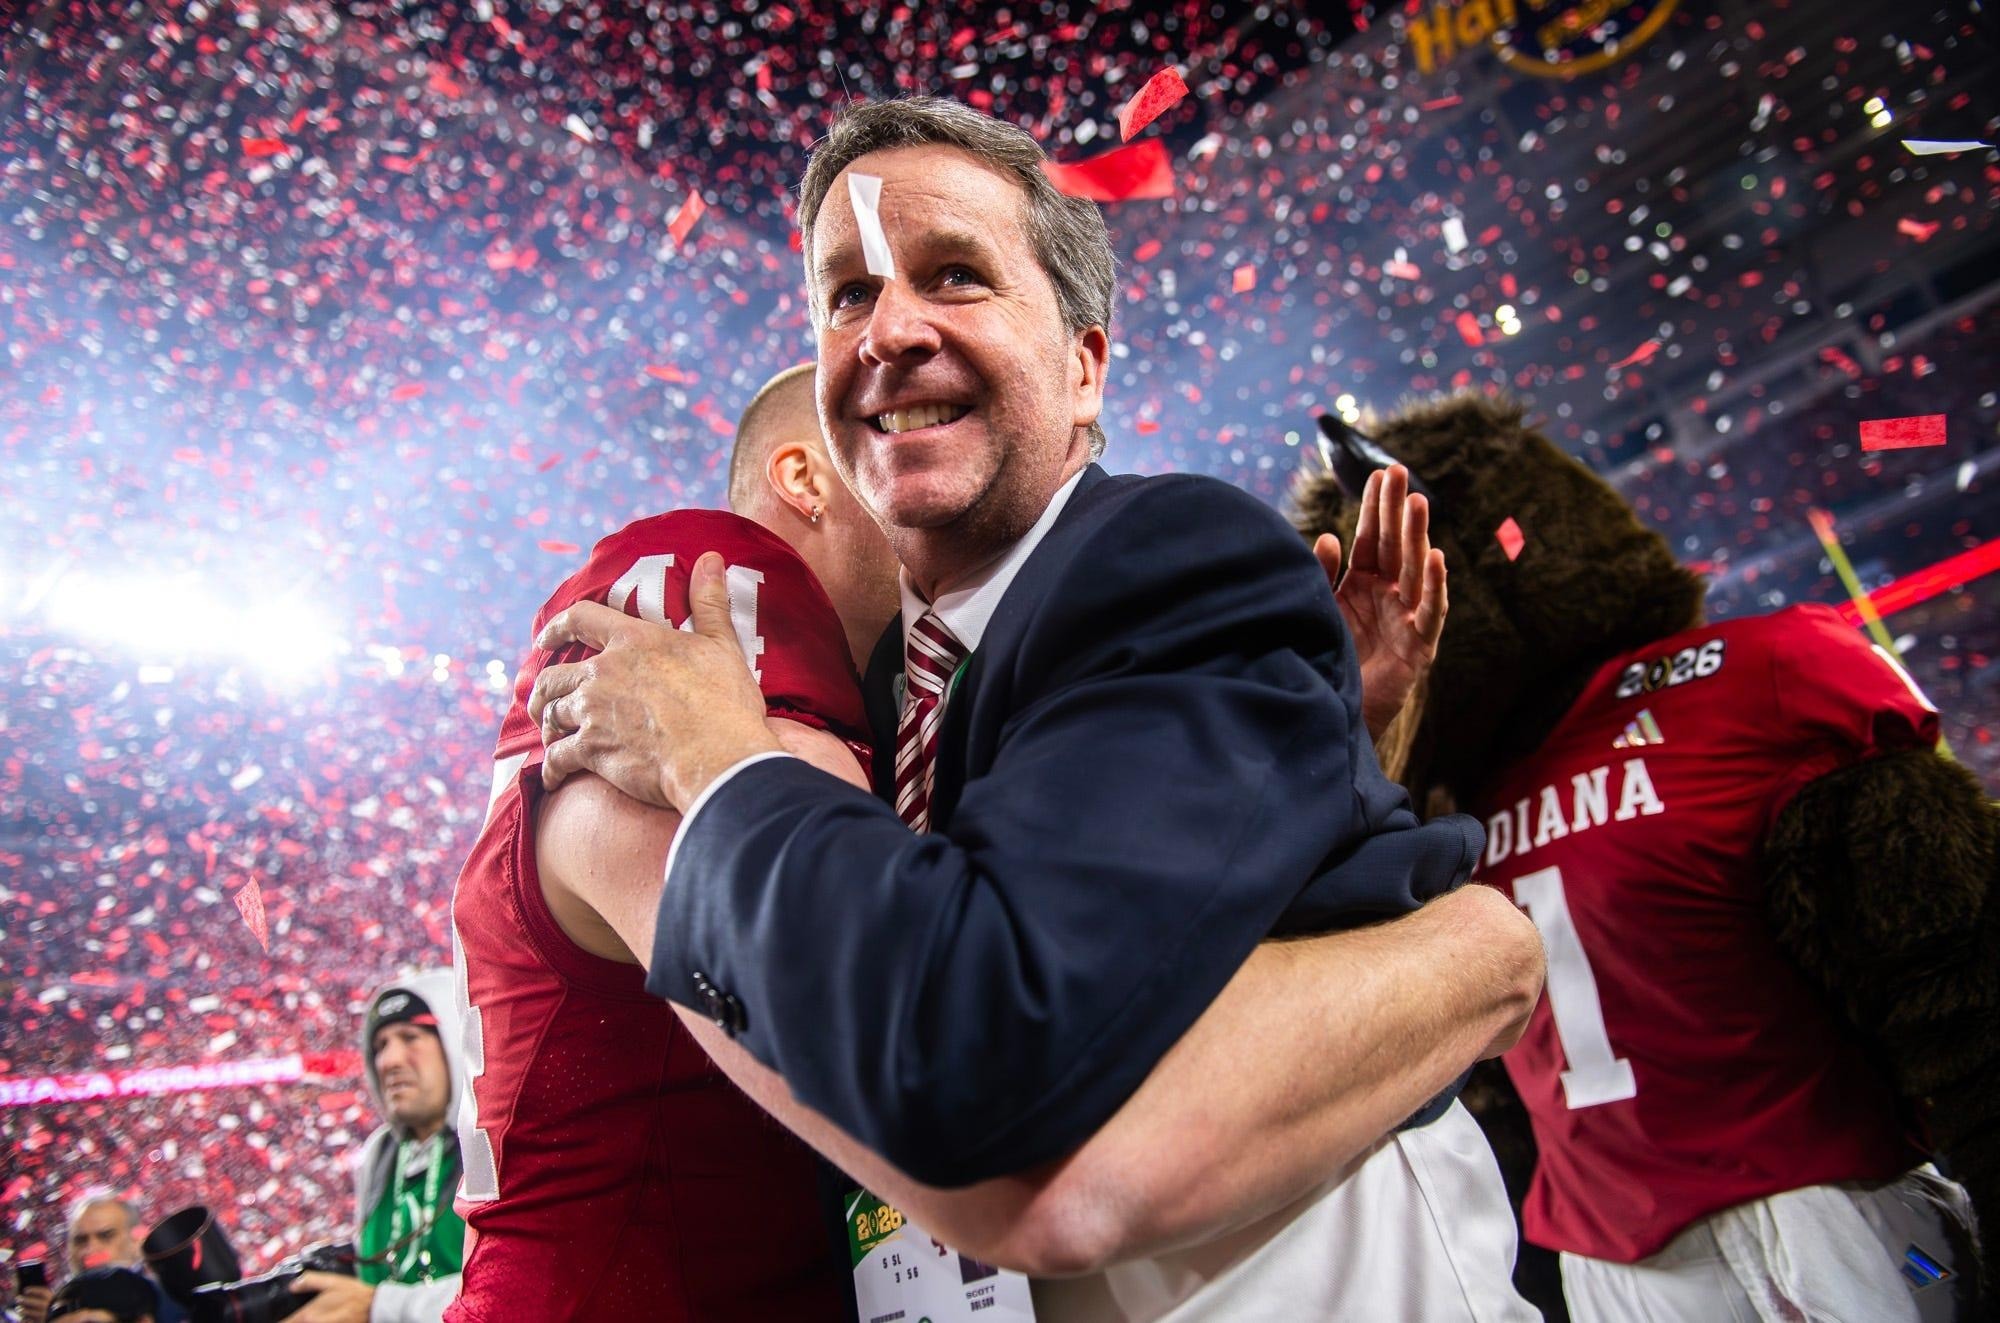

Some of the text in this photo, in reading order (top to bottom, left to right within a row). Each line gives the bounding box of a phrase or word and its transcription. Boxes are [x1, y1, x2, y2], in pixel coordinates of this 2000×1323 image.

[1616, 638, 1726, 699] 2026
[1484, 757, 1665, 867] DIANA
[1512, 865, 1637, 1110] 1
[856, 1205, 902, 1241] 2026
[966, 1284, 995, 1299] SCOTT
